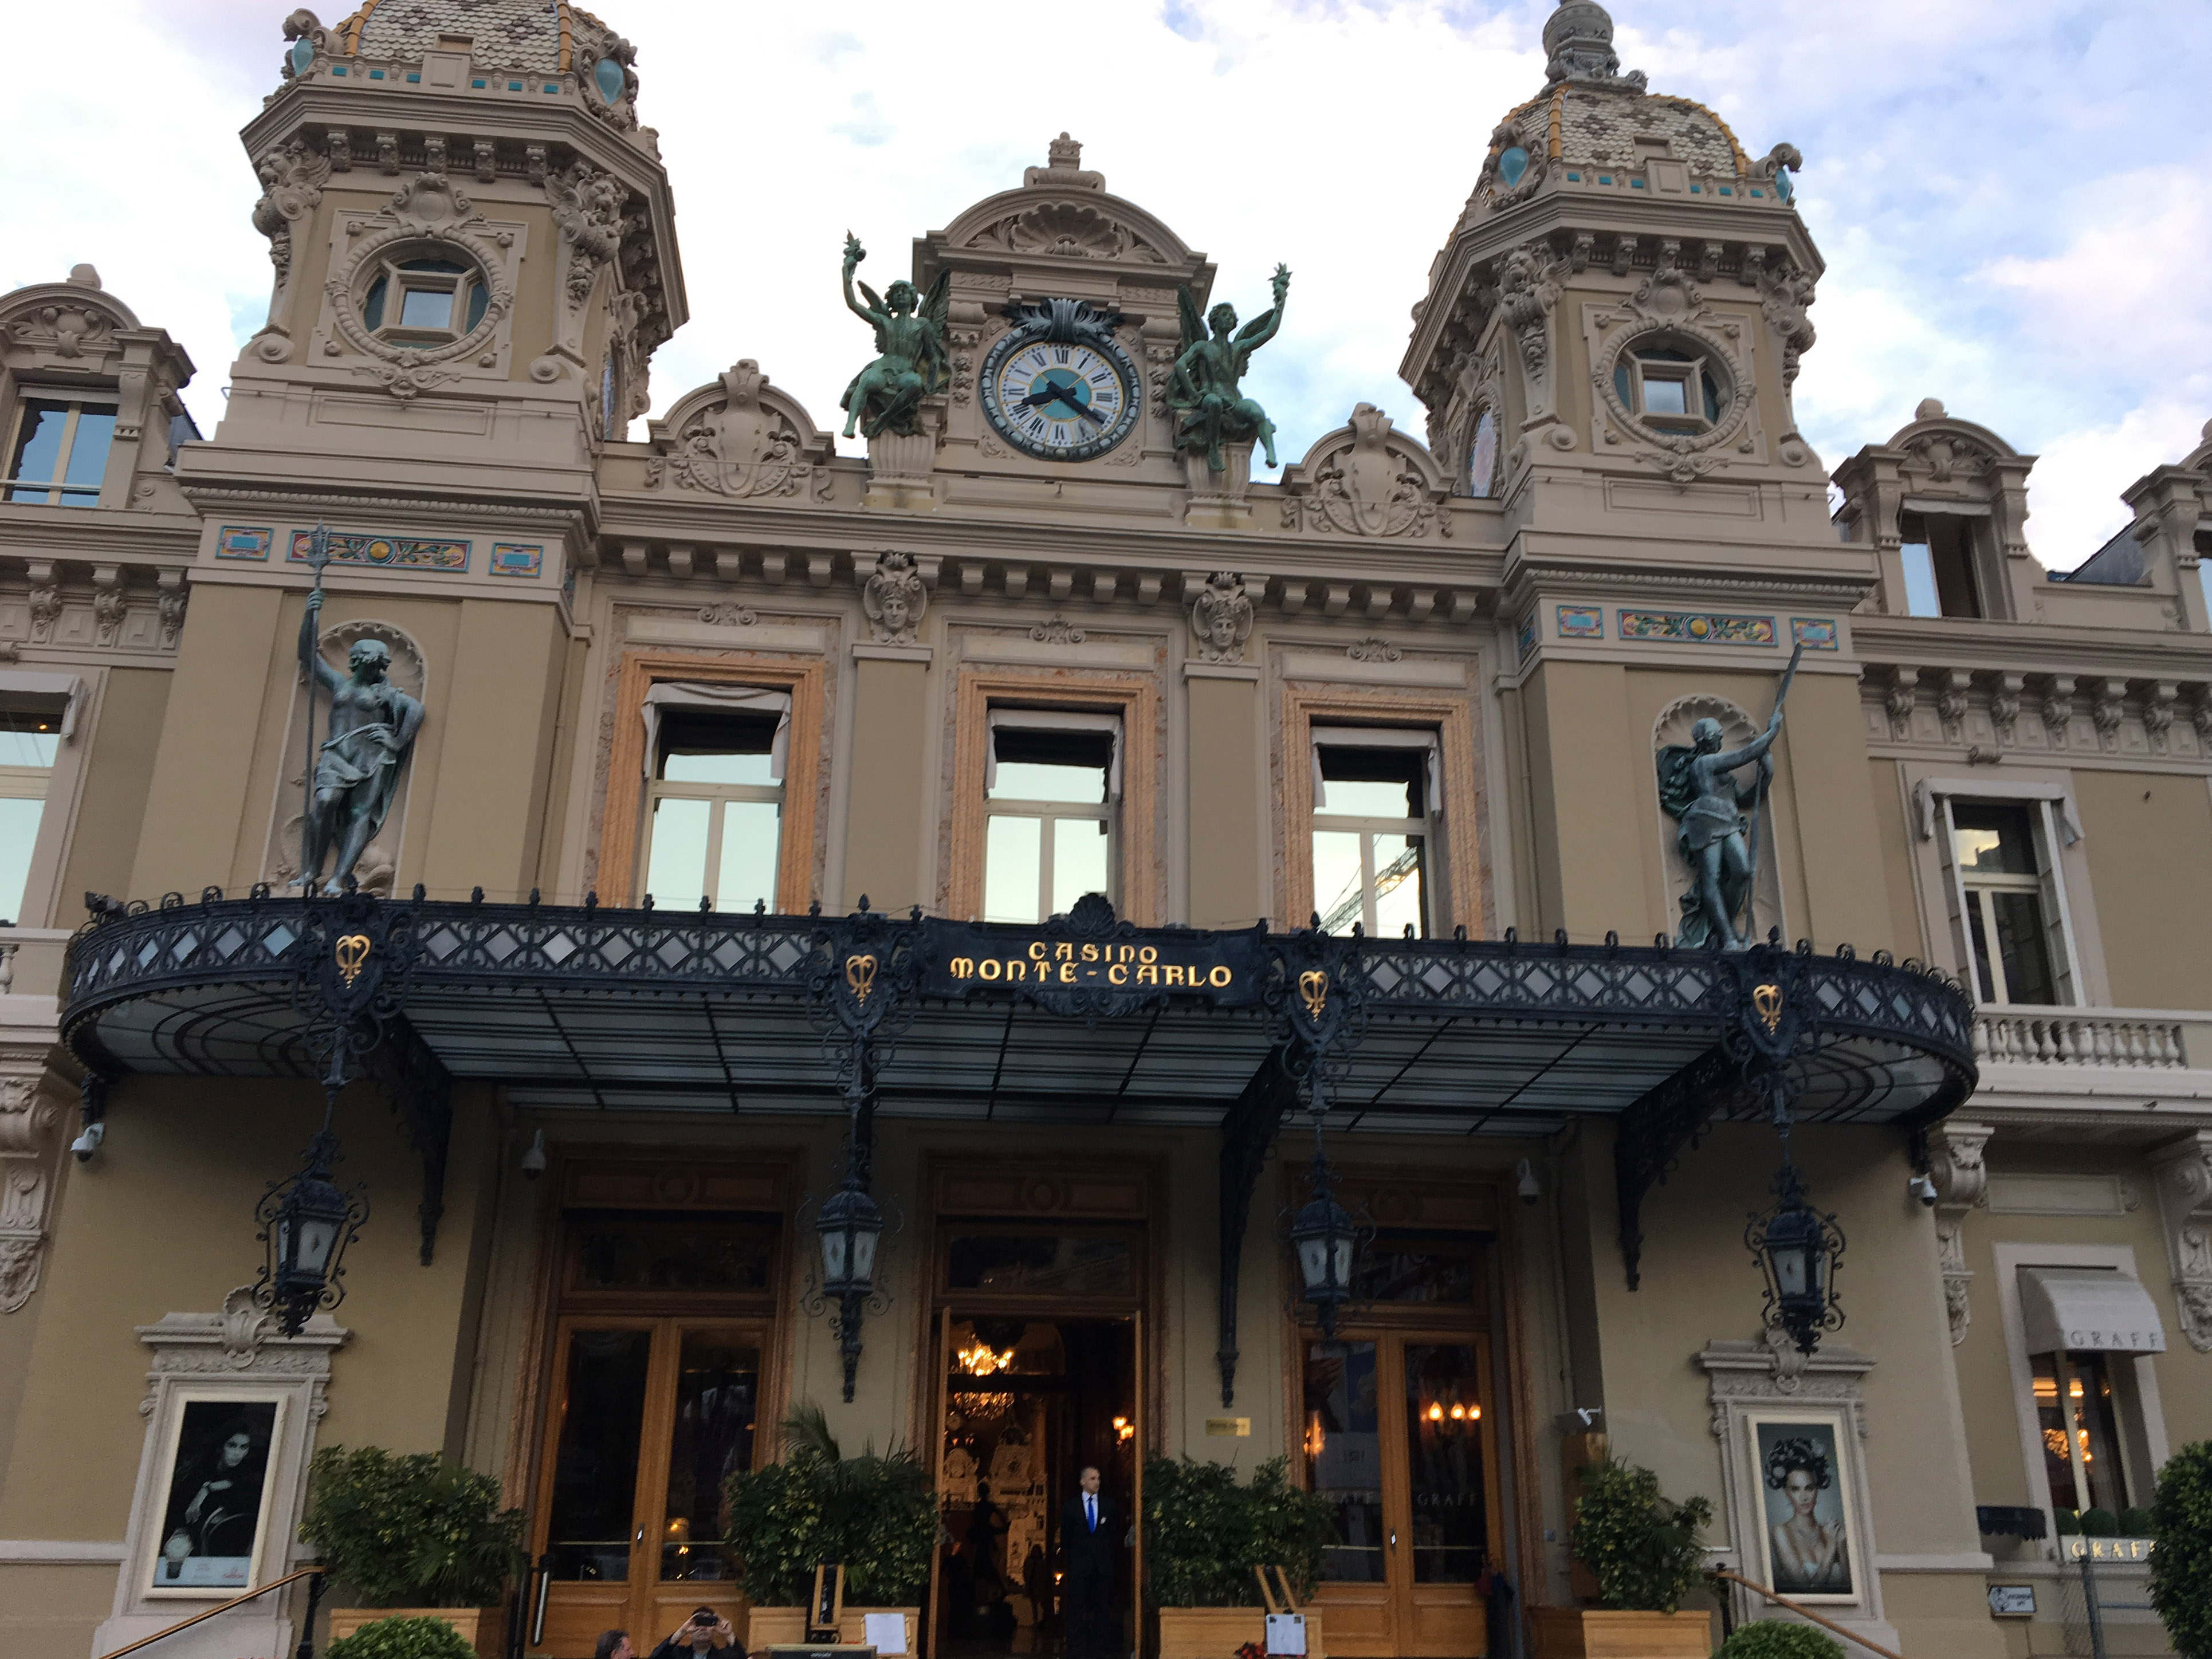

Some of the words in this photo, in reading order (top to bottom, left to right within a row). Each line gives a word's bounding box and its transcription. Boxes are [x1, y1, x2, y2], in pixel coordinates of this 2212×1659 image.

[1028, 941, 1158, 965] CASINO
[2070, 1330, 2159, 1349] GRAFF
[1417, 1492, 1479, 1508] GRAFF
